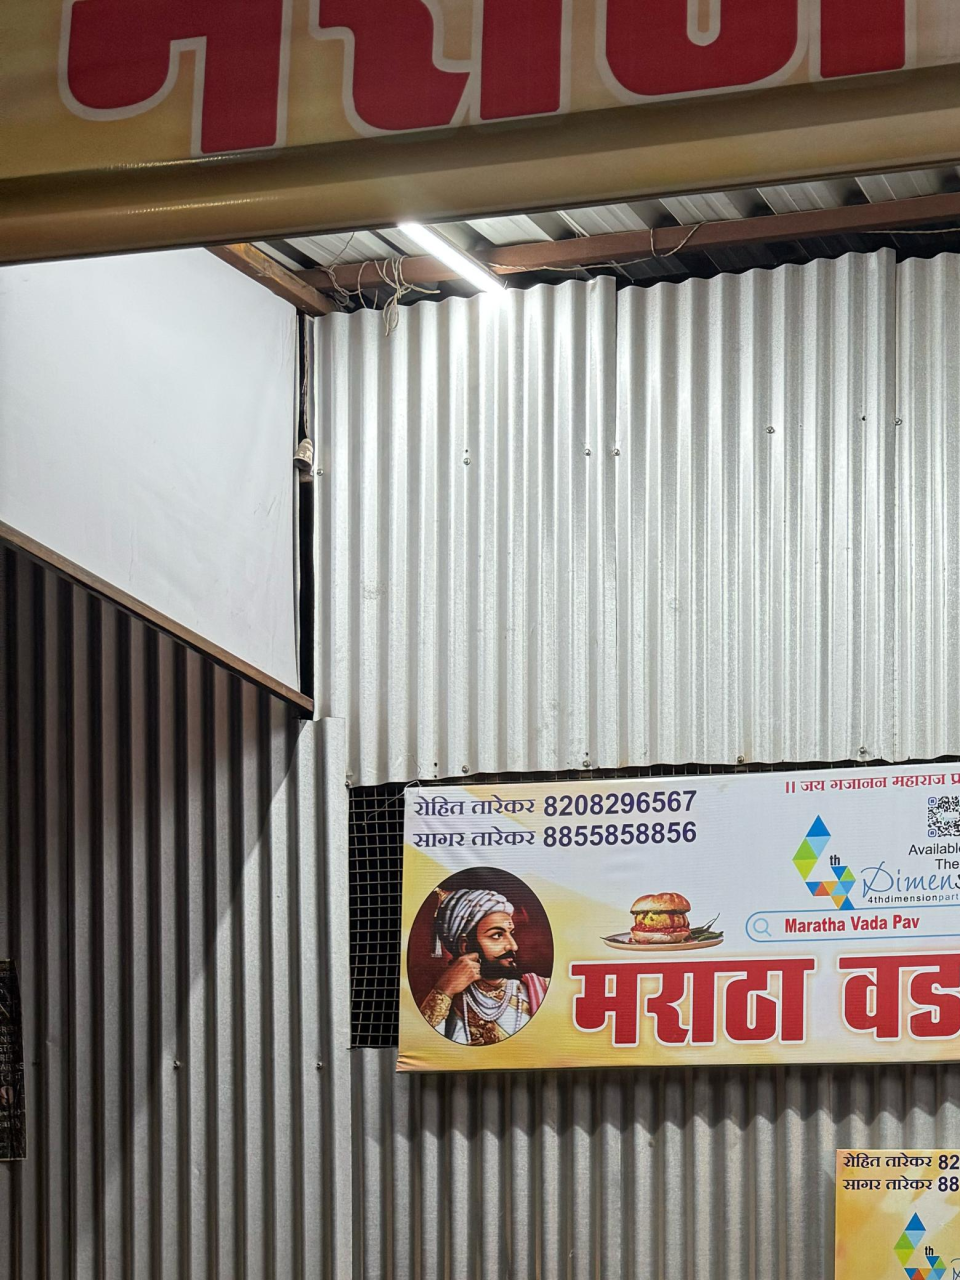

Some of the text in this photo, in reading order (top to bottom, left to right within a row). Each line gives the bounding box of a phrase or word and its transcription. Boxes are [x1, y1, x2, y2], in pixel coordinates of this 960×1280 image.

[800, 780, 826, 792] जय
[830, 776, 888, 791] गजानन
[891, 773, 946, 788] महाराज
[413, 789, 697, 817] रोहित तारेकर 8208296567
[412, 820, 697, 848] सागर तारेकर 8855858856
[934, 858, 960, 871] The
[784, 914, 920, 933] Maratha Vada Pav
[570, 956, 817, 1047] मराठा
[842, 1151, 881, 1169] रोहित
[884, 1151, 932, 1168] तारेकर
[842, 1178, 881, 1191] सागर
[884, 1174, 933, 1191] तारेकर
